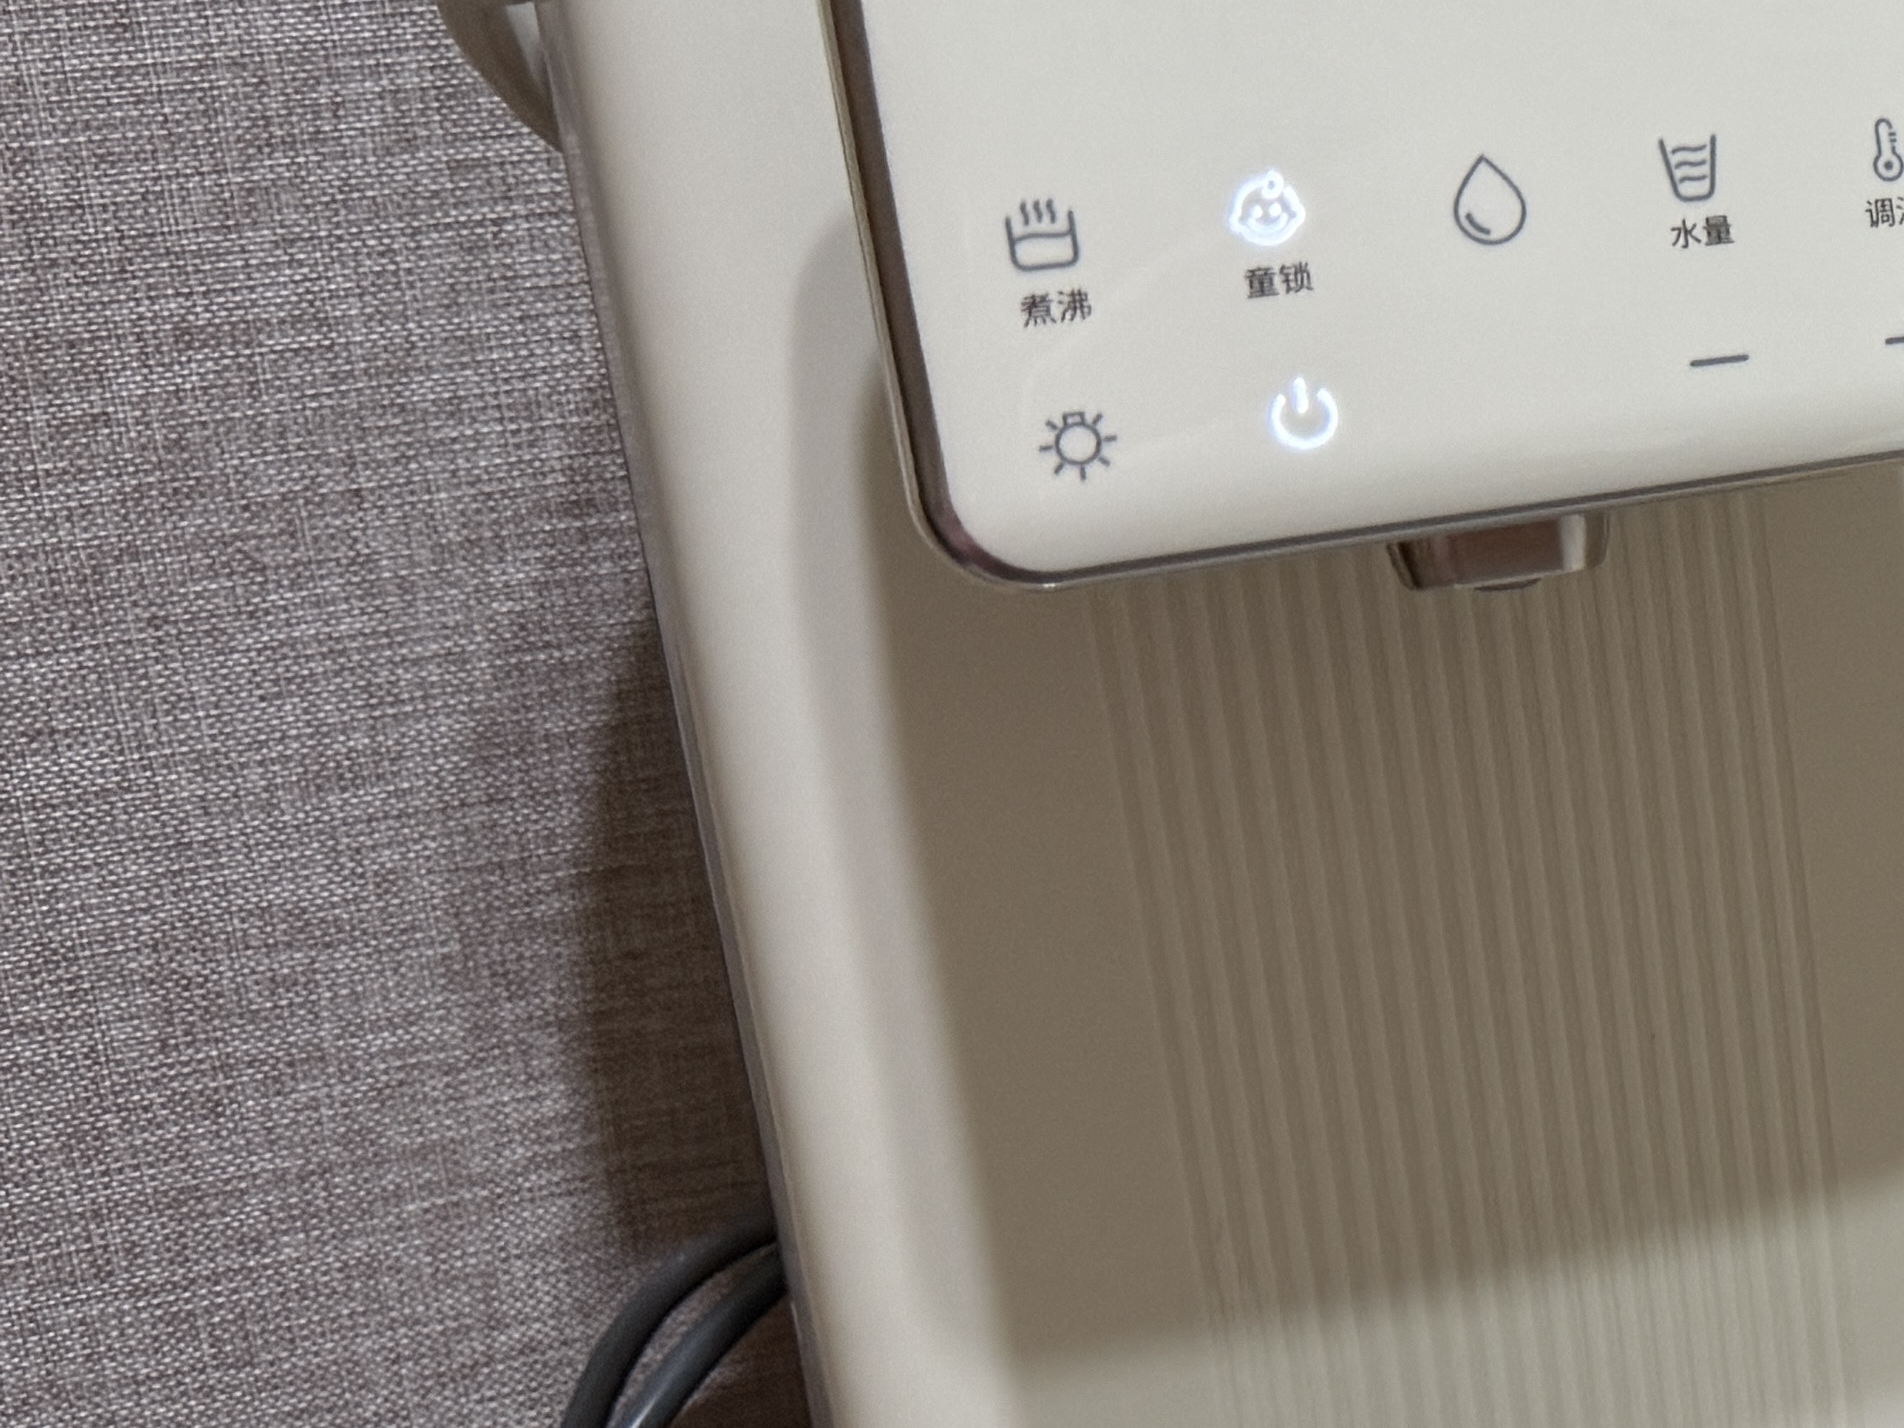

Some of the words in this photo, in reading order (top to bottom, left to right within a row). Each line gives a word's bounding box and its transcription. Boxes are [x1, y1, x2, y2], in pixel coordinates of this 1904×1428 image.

[1669, 214, 1734, 250] 水量
[1243, 260, 1314, 301] 童锁
[1019, 287, 1093, 328] 煮沸
